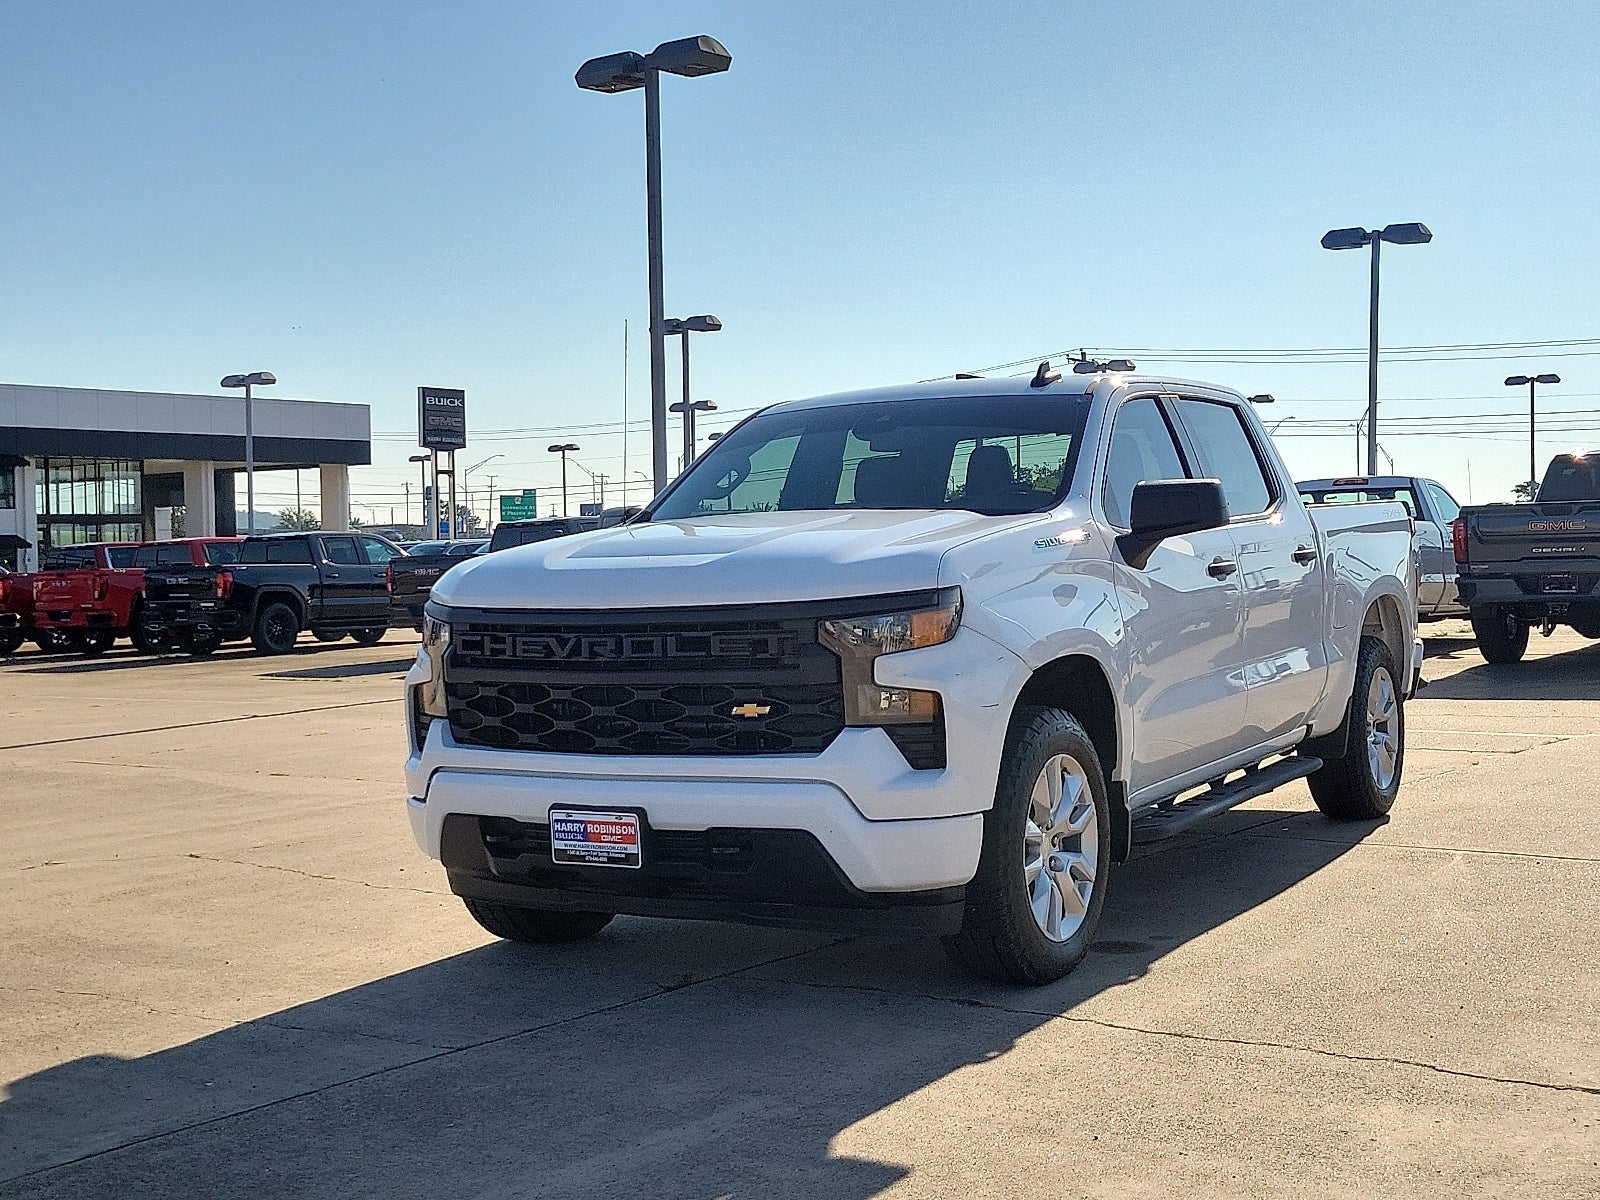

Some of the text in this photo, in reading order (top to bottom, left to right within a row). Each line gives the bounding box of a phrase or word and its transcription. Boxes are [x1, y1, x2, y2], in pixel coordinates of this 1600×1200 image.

[426, 397, 463, 407] BUICK
[429, 416, 463, 427] GMC
[1528, 520, 1586, 531] GMC
[455, 633, 790, 659] CHEVROLET
[554, 822, 635, 835] HARRY ROBINSON
[555, 832, 585, 841] BUICK
